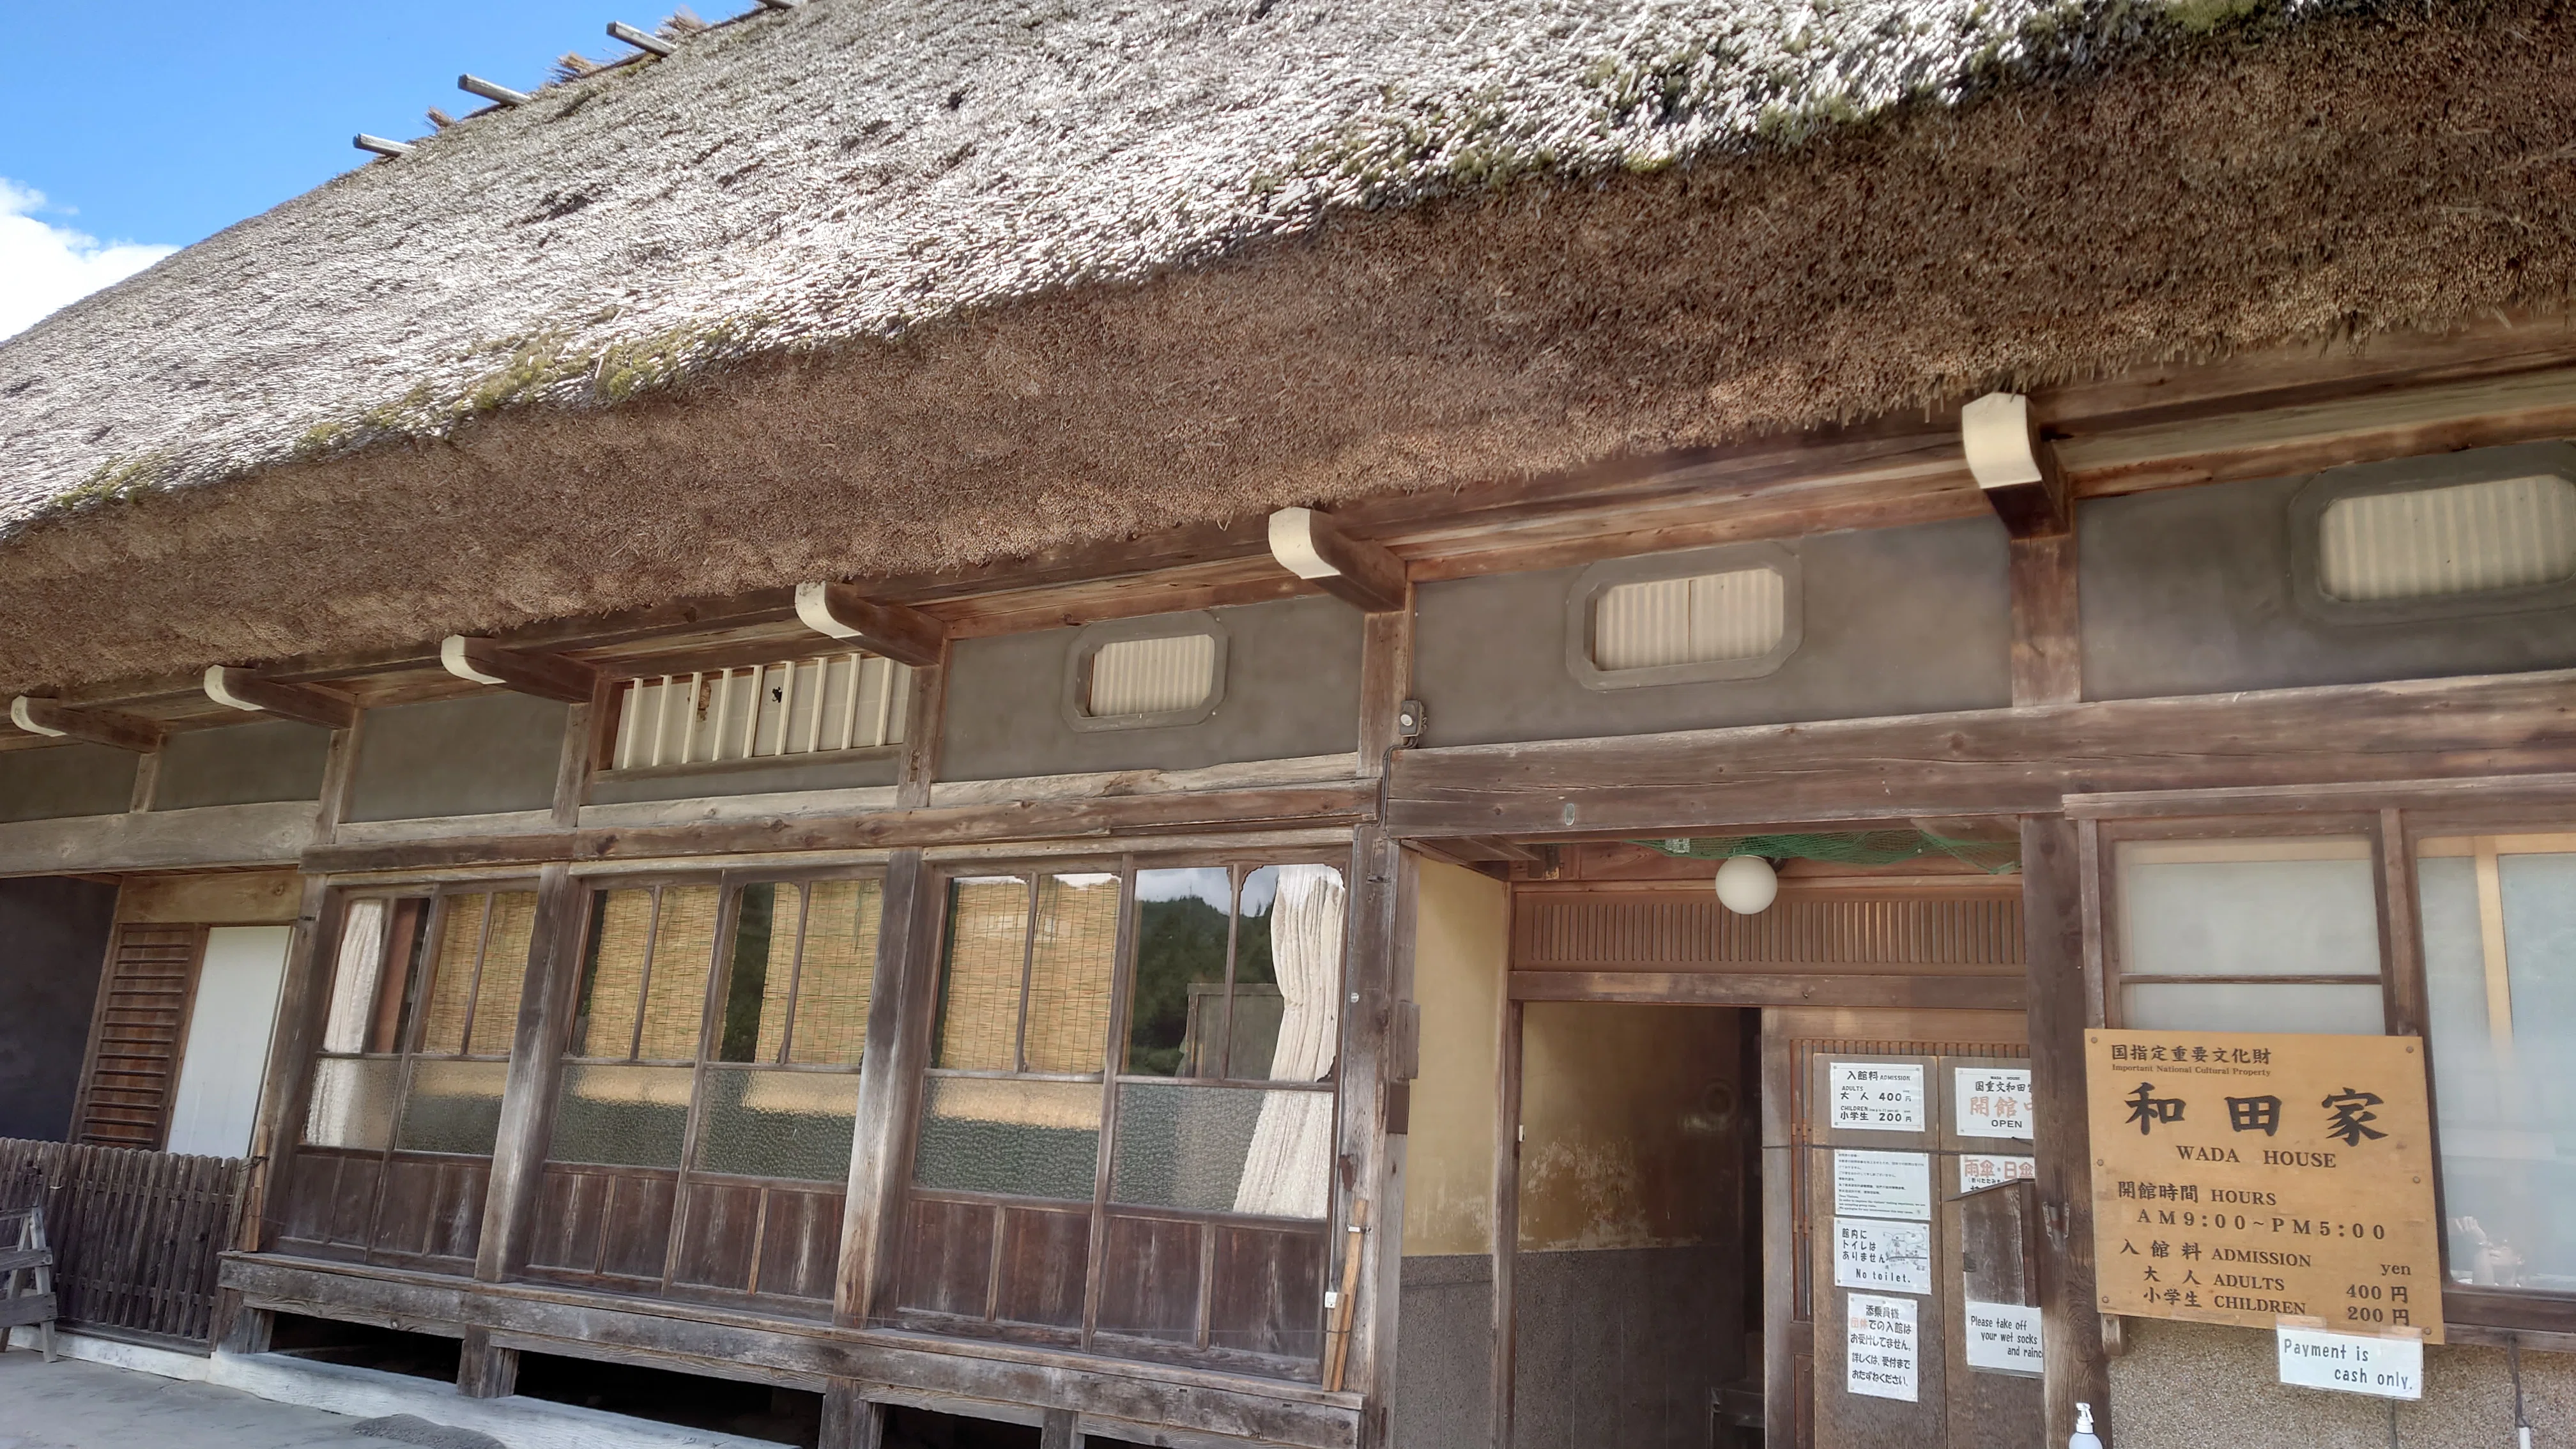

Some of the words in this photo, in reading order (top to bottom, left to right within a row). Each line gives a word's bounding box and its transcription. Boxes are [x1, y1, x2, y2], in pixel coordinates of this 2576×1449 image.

[2111, 1044, 2272, 1065] 国指定重要文化財
[1846, 1071, 1879, 1081] 入館料
[2195, 1066, 2230, 1075] Cultural
[2233, 1068, 2271, 1077] Property
[1878, 1092, 1902, 1101] 400
[1840, 1111, 1869, 1121] 小学生
[1878, 1112, 1902, 1122] 200
[2124, 1081, 2389, 1147] 和田家
[1991, 1119, 2023, 1128] OPEN
[2175, 1146, 2241, 1163] WADA
[2264, 1150, 2336, 1169] HOUSE
[2117, 1181, 2198, 1203] 開館時間
[2211, 1189, 2277, 1206] HOURS
[1842, 1228, 1867, 1239] 館内に
[1843, 1239, 1876, 1252] トイレは
[2120, 1238, 2202, 1262] 入館料
[2211, 1248, 2312, 1268] ADMISSION
[1842, 1250, 1885, 1264] ありません
[1856, 1268, 1867, 1278] No
[2380, 1263, 2411, 1276] yen
[2213, 1273, 2285, 1291] ADULTS
[2346, 1284, 2382, 1300] 400
[2391, 1285, 2408, 1304] 円
[1866, 1305, 1899, 1320] 添乗員様
[2143, 1287, 2202, 1308] 小学生
[2214, 1295, 2307, 1315] CHILDREN
[2347, 1306, 2384, 1322] 200
[2392, 1308, 2409, 1326] 円
[1851, 1317, 1912, 1335] 団体での入館は
[1970, 1315, 1993, 1328] Please
[1996, 1318, 2012, 1330] take
[2015, 1320, 2027, 1331] off
[1850, 1333, 1912, 1351] お受けしてません。
[1981, 1331, 1997, 1342] your
[2000, 1331, 2013, 1342] wet
[2017, 1333, 2038, 1345] socks
[2007, 1346, 2020, 1356] and
[2023, 1347, 2043, 1358] rainc
[2283, 1338, 2347, 1360] Payment
[2356, 1346, 2369, 1362] is
[1851, 1370, 1908, 1387] おたずねください。
[2334, 1367, 2368, 1384] cash
[2377, 1372, 2413, 1390] only.
